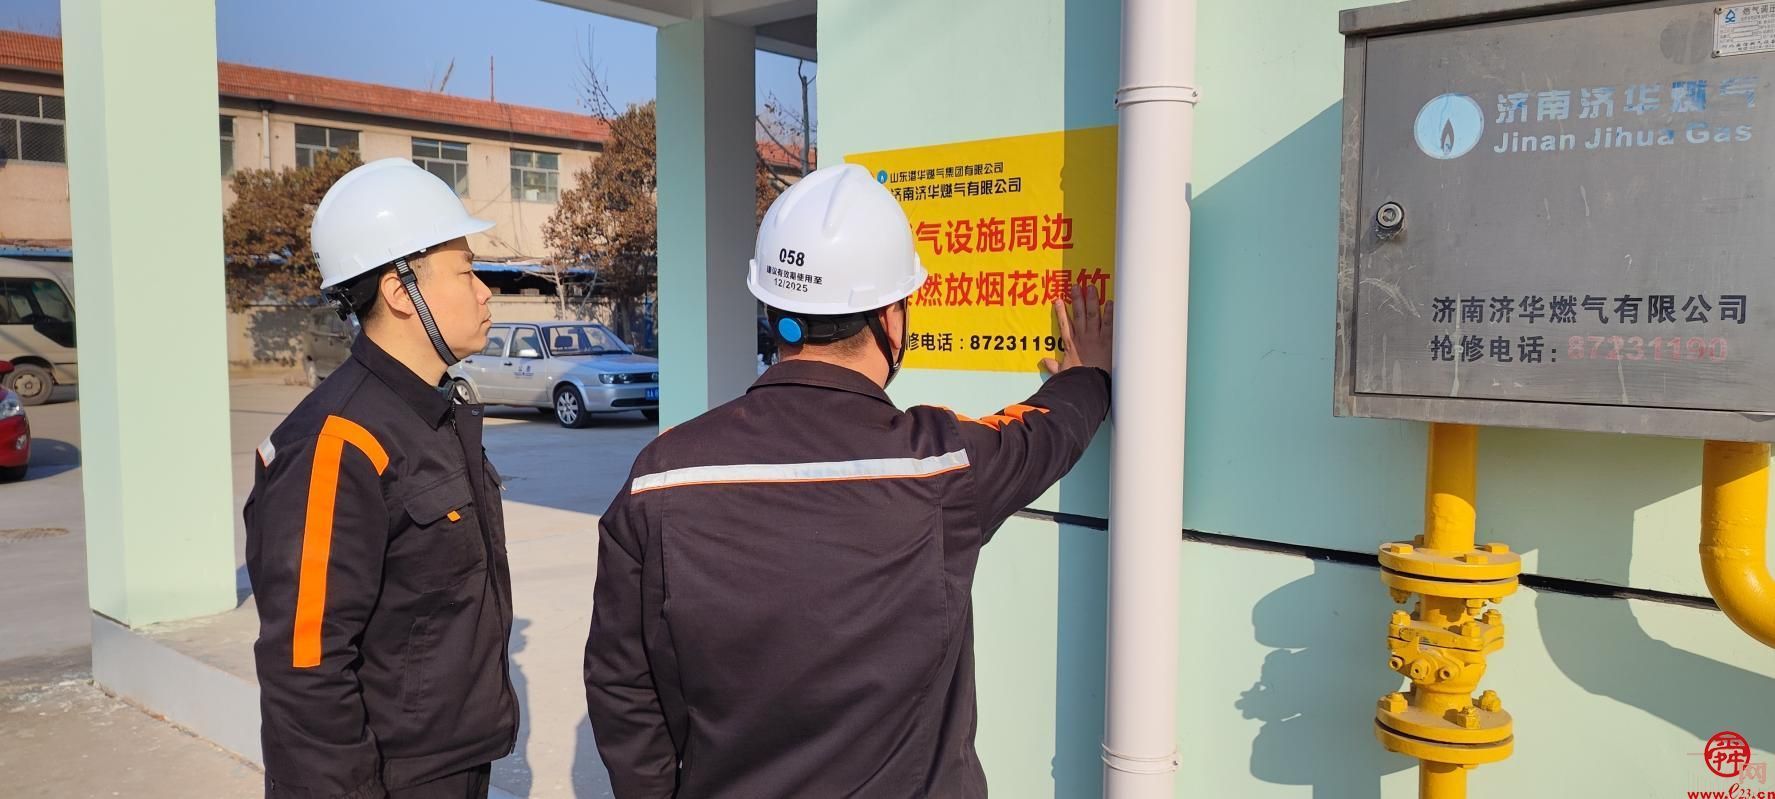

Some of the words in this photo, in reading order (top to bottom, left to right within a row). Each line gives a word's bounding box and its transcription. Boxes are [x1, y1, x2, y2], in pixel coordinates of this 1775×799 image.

[1493, 132, 1576, 153] Jinan
[1584, 126, 1675, 149] Jihua
[1685, 121, 1753, 144] Gas
[889, 161, 1004, 183] 山东港华燃气集团有限公司
[910, 213, 1074, 256] 气设施周边
[779, 248, 805, 266] 058
[774, 278, 808, 292] 12/2025
[908, 268, 1111, 307] 燃放烟花爆竹
[1431, 294, 1747, 324] 济南济华燃气有限公司
